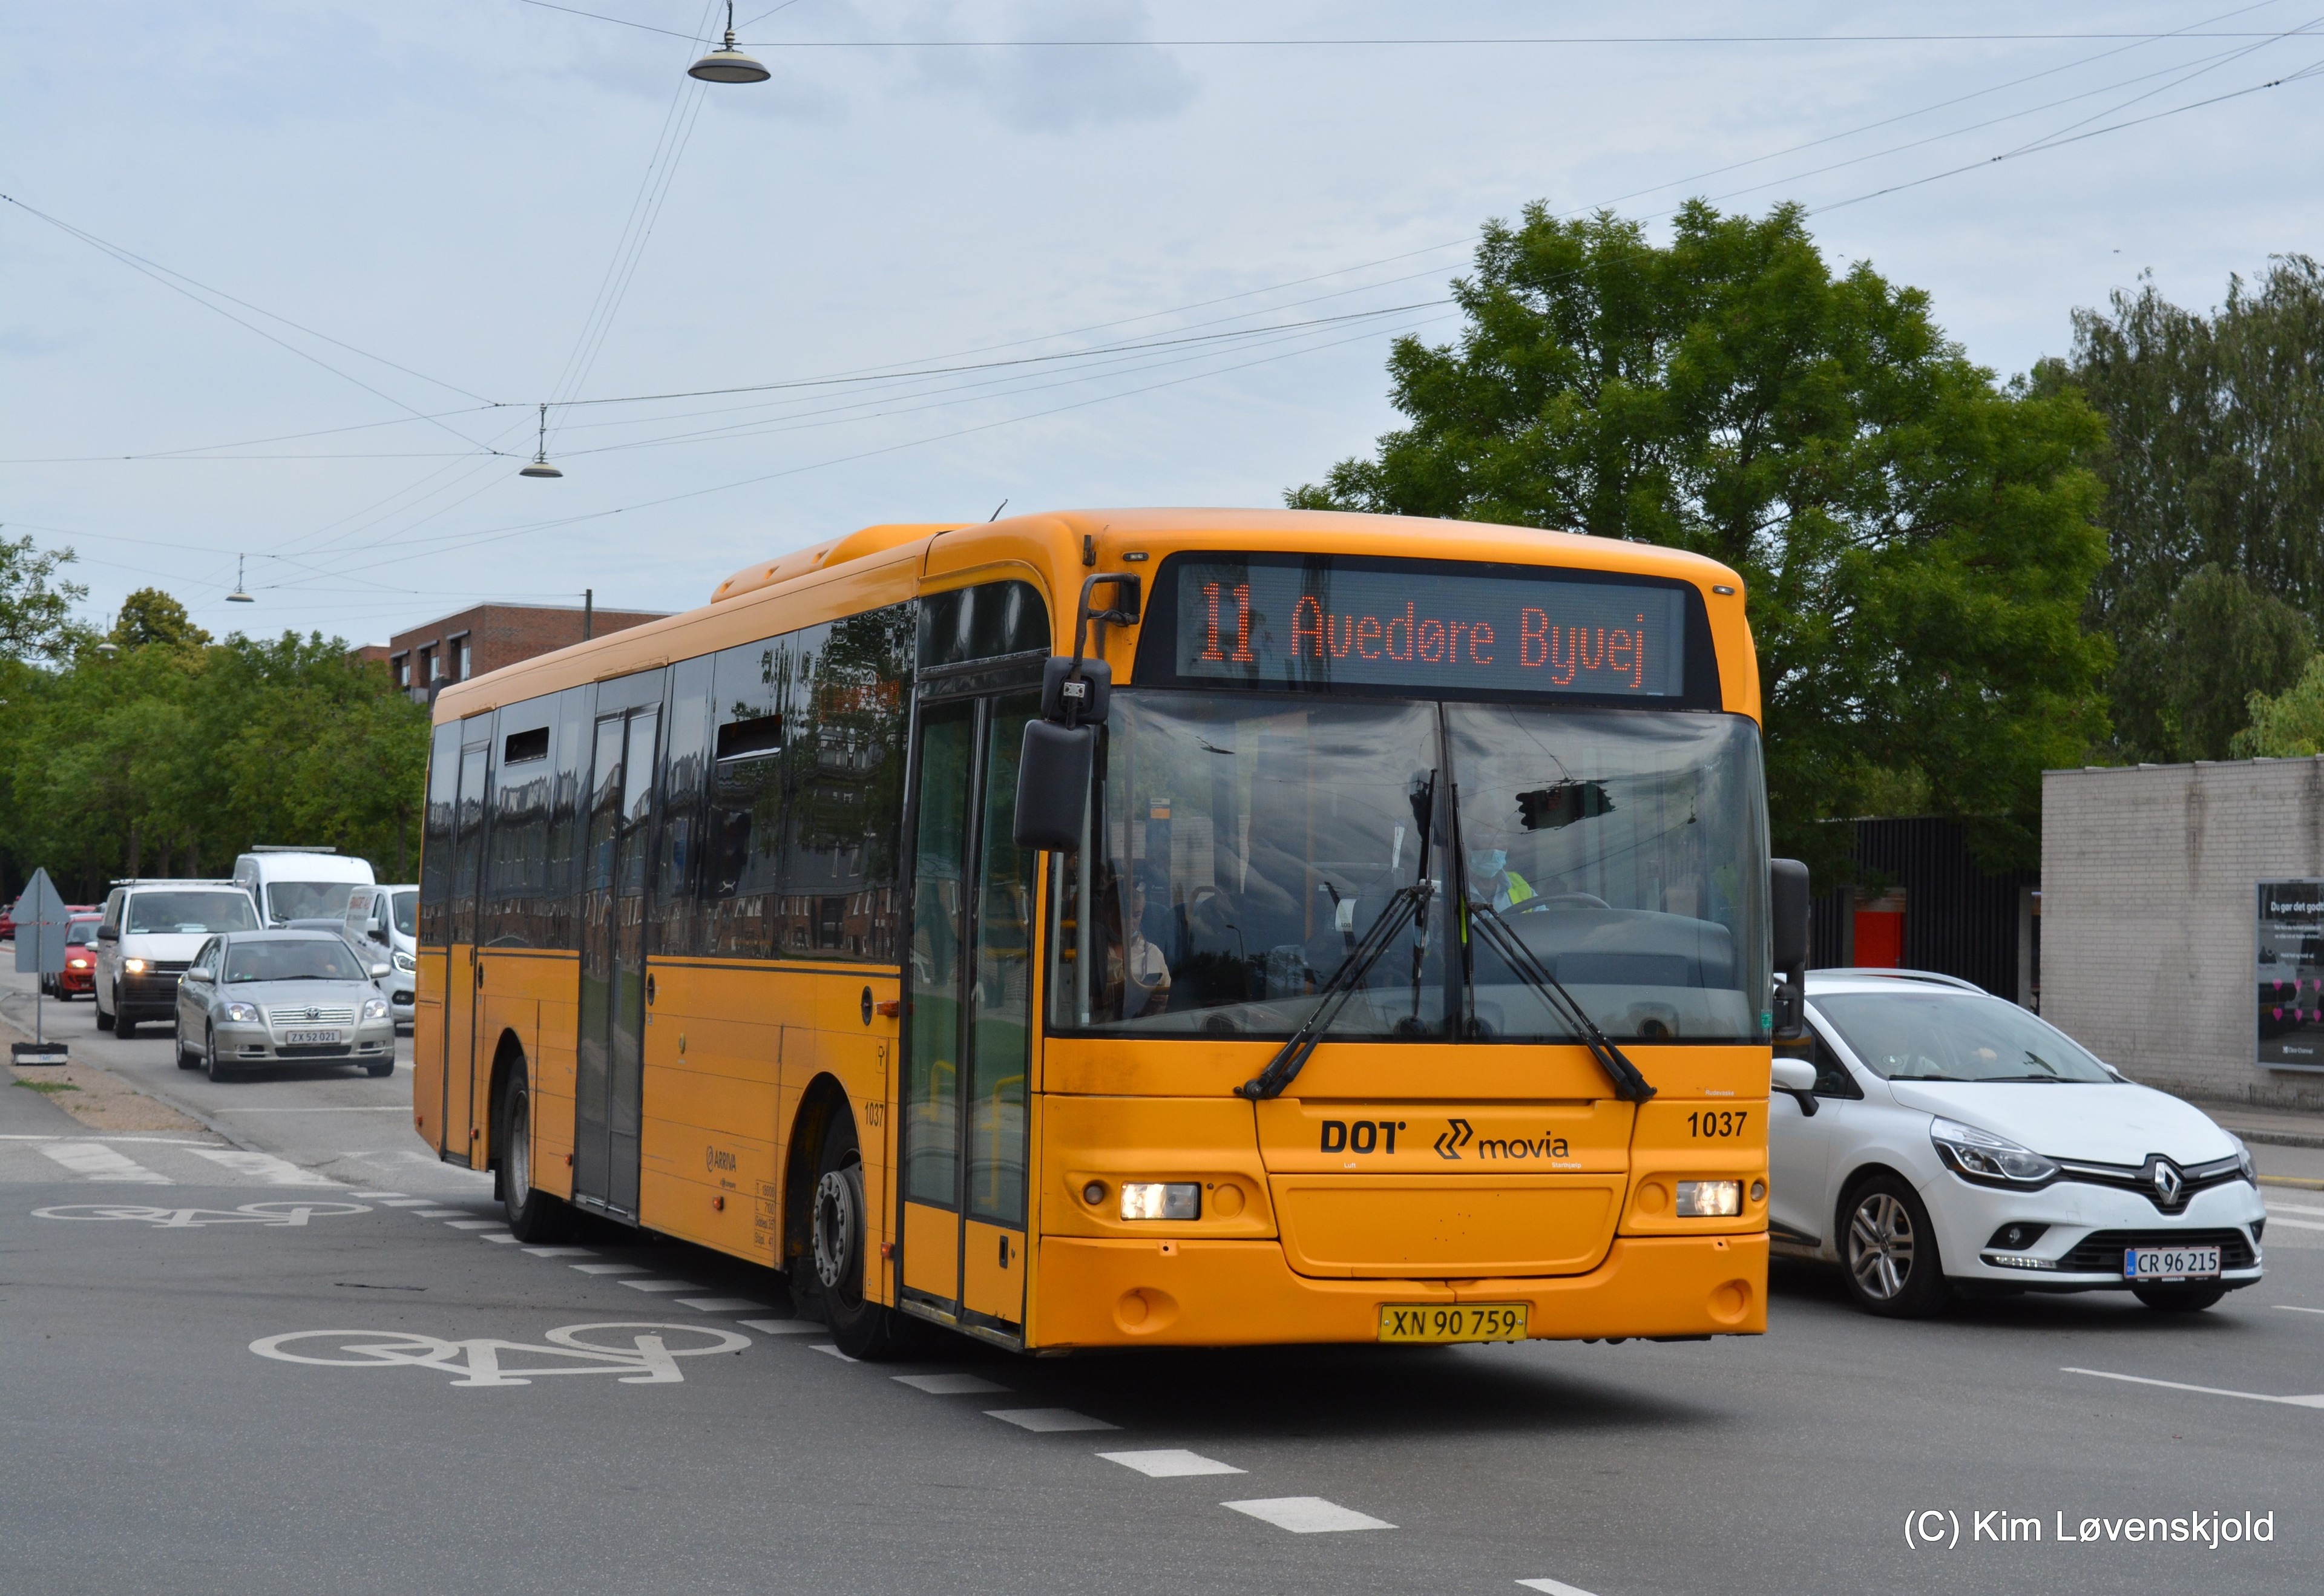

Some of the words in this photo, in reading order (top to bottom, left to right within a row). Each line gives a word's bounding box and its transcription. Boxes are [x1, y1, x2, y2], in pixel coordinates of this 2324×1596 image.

[1202, 582, 1253, 661] 11
[1291, 596, 1494, 664] Avedøre
[1521, 607, 1643, 688] Byvej
[2271, 901, 2280, 911] Du
[2280, 903, 2293, 913] gør
[2293, 902, 2305, 911] det
[292, 1033, 304, 1042] ZX
[306, 1033, 317, 1041] 52
[320, 1032, 335, 1040] 021
[865, 1101, 884, 1128] 1037
[1687, 1111, 1748, 1138] 1037
[1321, 1120, 1406, 1155] DOT
[1479, 1130, 1569, 1160] movia
[715, 1150, 737, 1172] ARRIVA
[2138, 1254, 2159, 1272] CR
[2164, 1253, 2184, 1272] 96
[2188, 1252, 2217, 1271] 215
[1392, 1311, 1426, 1336] XN
[1434, 1310, 1462, 1335] 90
[1471, 1310, 1516, 1335] 759
